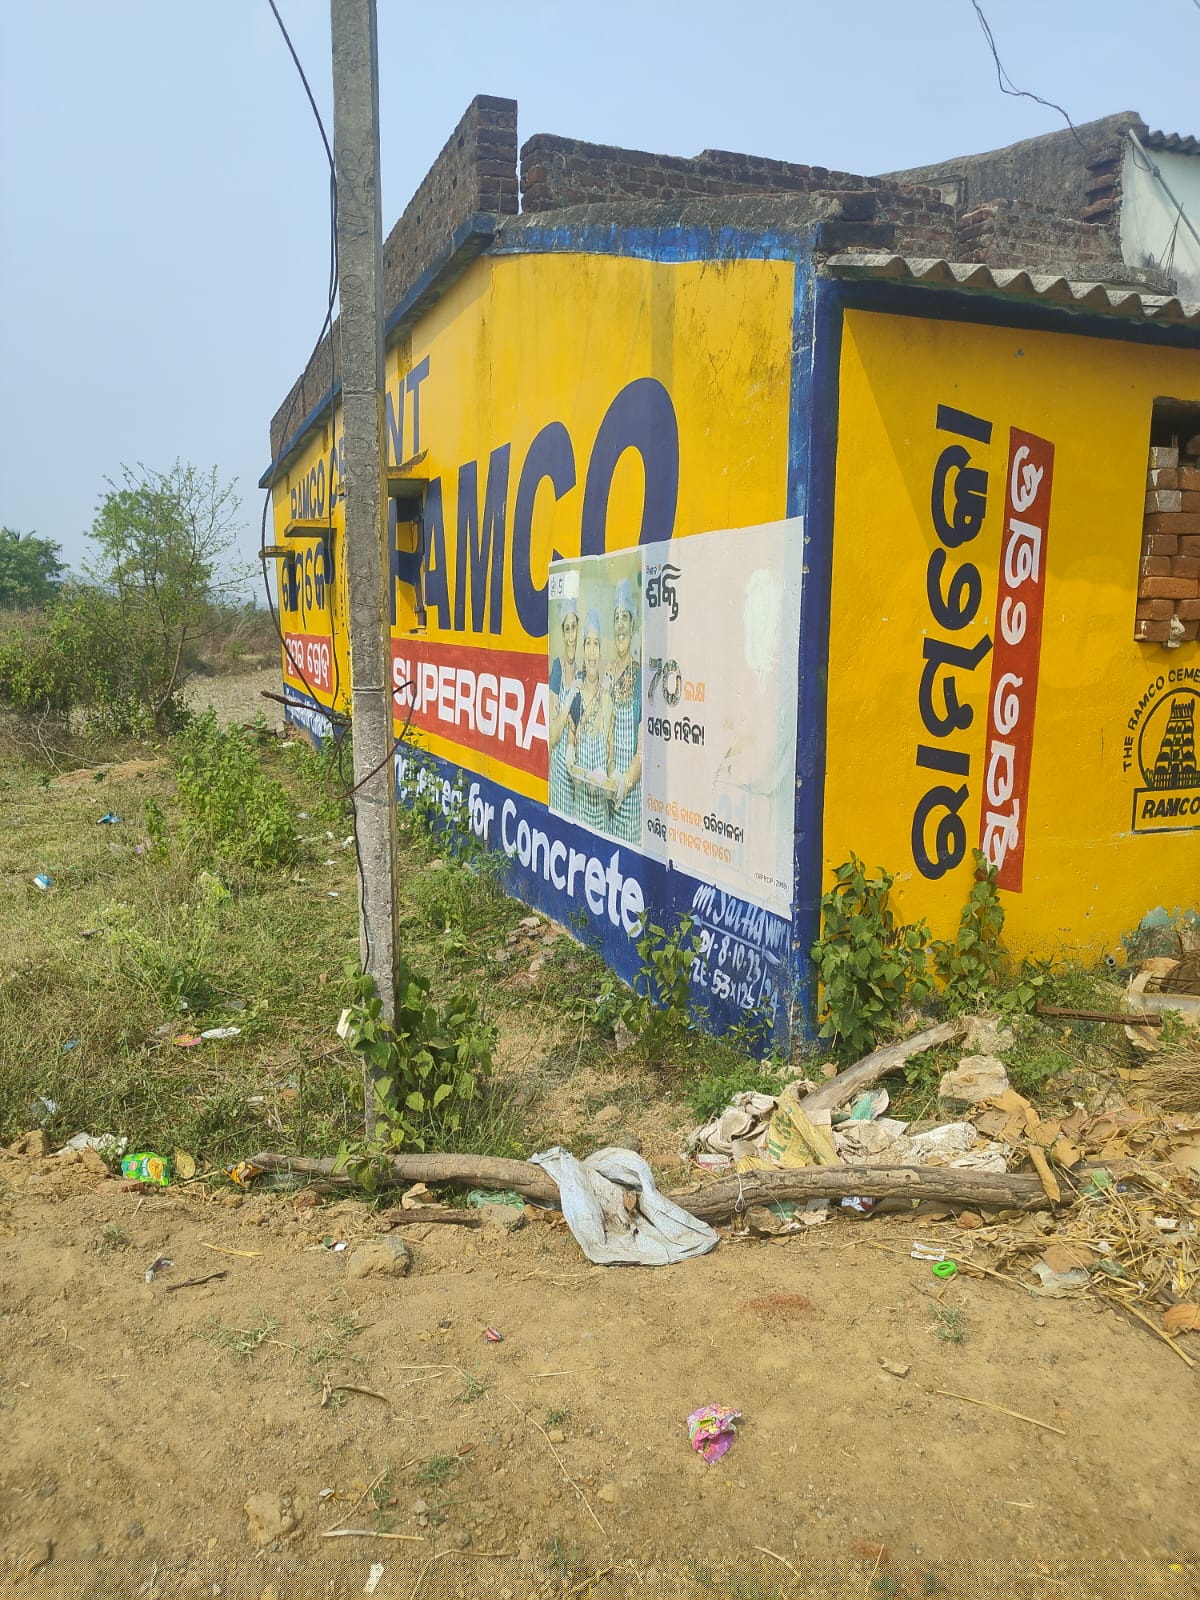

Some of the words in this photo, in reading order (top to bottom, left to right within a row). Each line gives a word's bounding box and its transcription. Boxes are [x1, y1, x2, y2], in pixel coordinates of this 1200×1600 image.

[389, 377, 679, 638] RAMCO
[1128, 675, 1165, 731] RAMCO
[1123, 735, 1134, 772] THE
[1142, 795, 1200, 819] RAMCO
[468, 782, 494, 840] for
[501, 798, 645, 939] Concrete
